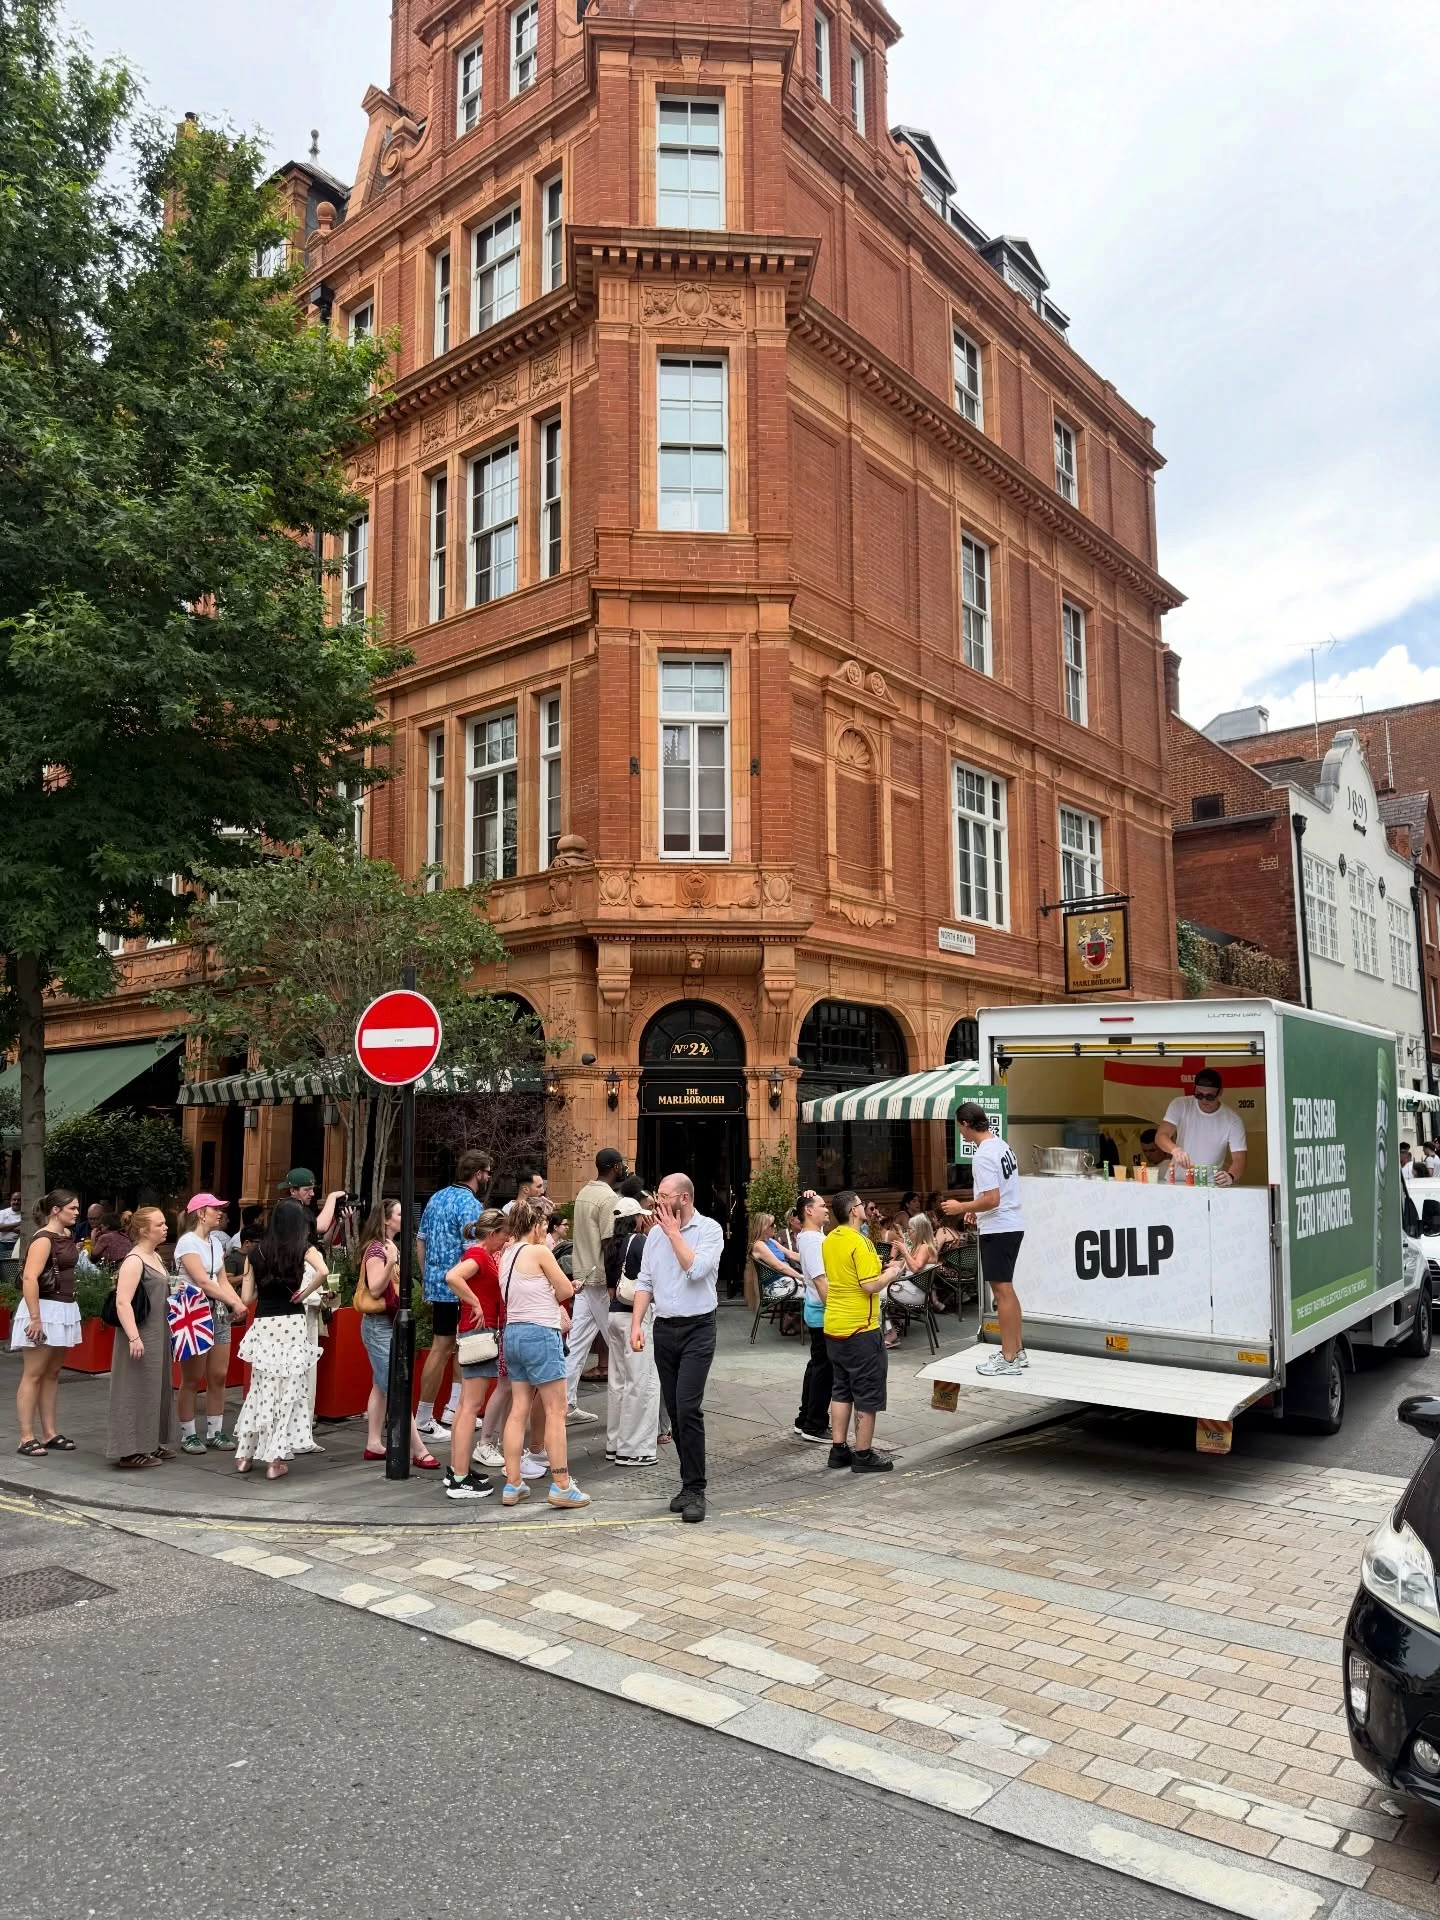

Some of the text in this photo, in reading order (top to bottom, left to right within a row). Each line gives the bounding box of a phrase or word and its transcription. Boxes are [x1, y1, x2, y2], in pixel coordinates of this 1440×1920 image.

[1347, 785, 1368, 824] 1891
[940, 930, 956, 941] NORTH
[956, 933, 967, 944] ROW
[1072, 977, 1122, 987] MARLBOROUGH
[688, 1042, 710, 1056] 24
[658, 1095, 725, 1105] MARLBOROUGH
[1238, 1100, 1255, 1109] 2026
[1292, 1097, 1313, 1140] ZERO
[1313, 1098, 1337, 1139] SUGAR
[1294, 1143, 1346, 1189] ZERO CALORIES
[1295, 1187, 1353, 1239] ZERO HANGOVER.
[1075, 1225, 1174, 1280] GULP
[1204, 1431, 1224, 1441] VFS
